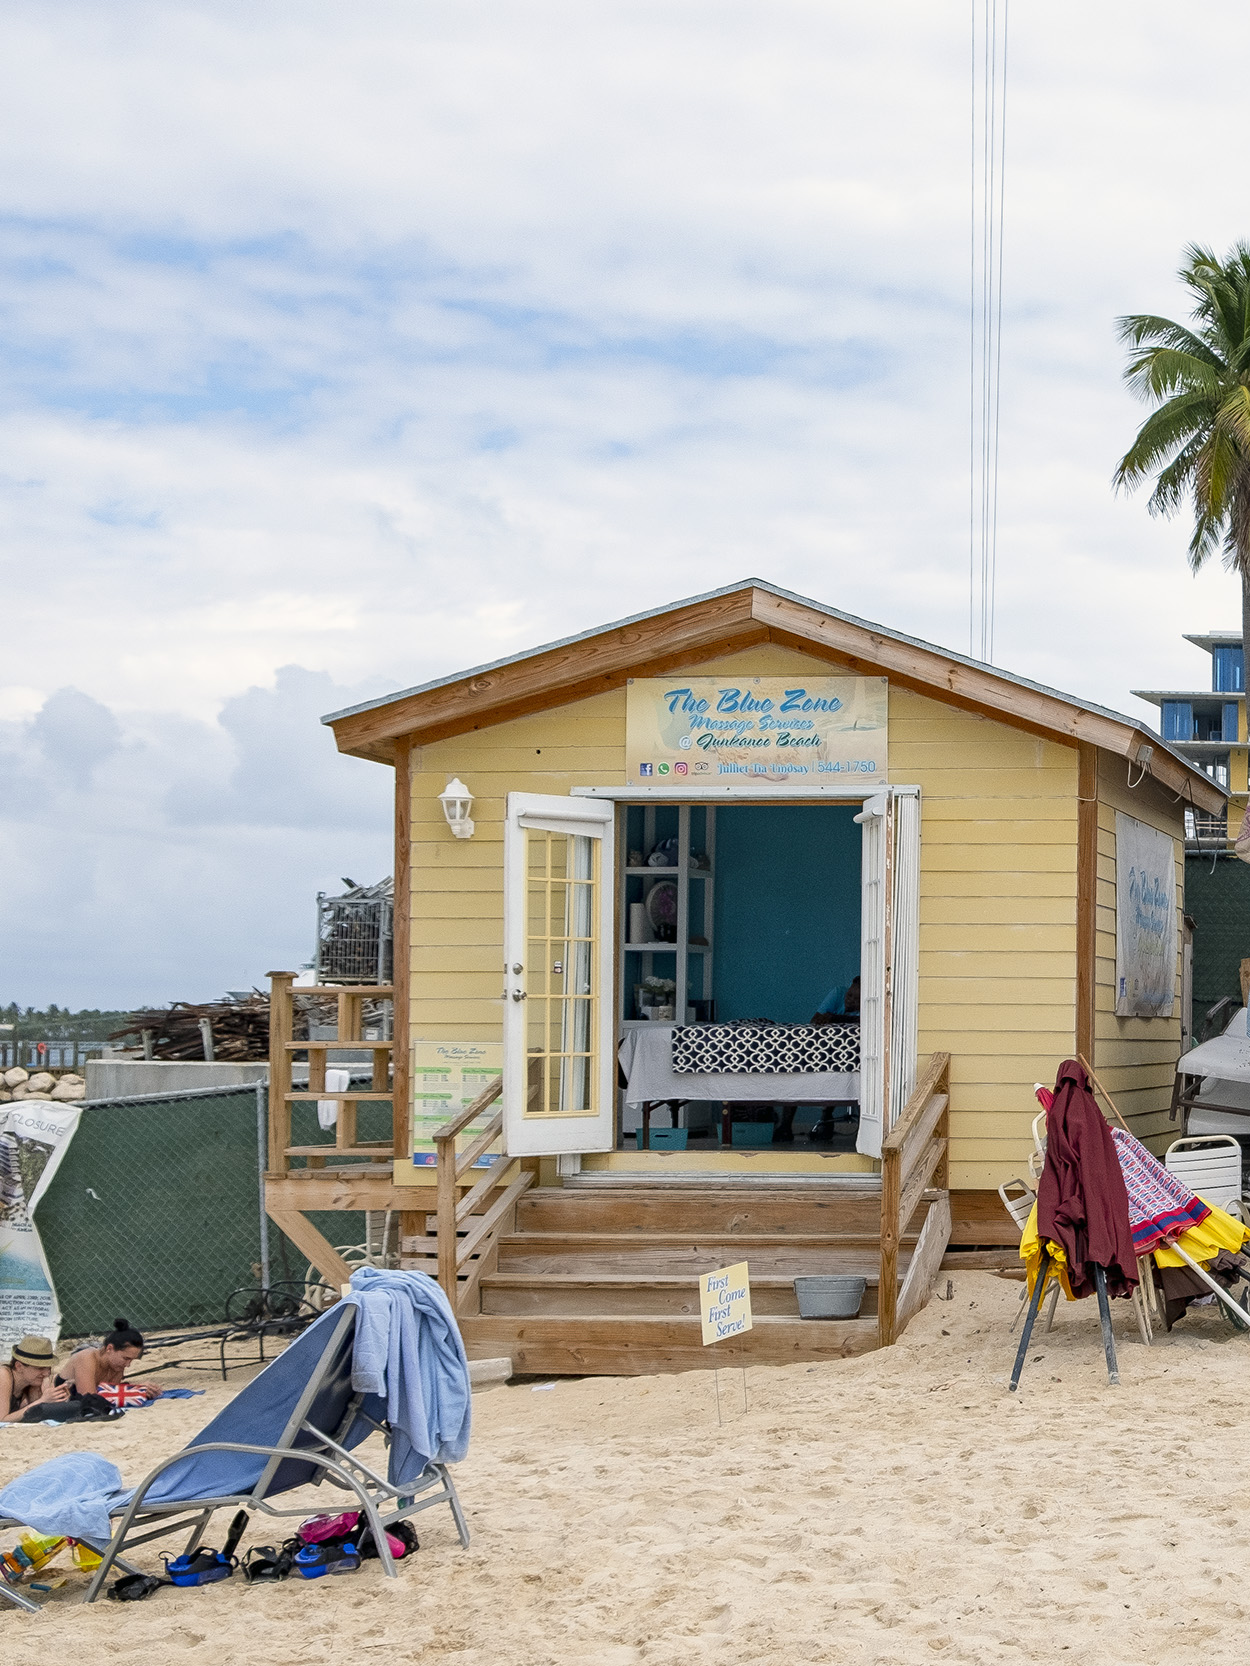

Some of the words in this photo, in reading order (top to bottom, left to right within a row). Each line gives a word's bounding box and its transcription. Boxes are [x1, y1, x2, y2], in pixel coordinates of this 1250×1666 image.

[663, 687, 710, 715] The
[716, 687, 774, 714] Blue
[779, 687, 844, 713] Zone
[688, 715, 754, 735] Massage
[758, 714, 816, 731] Services
[678, 735, 693, 750] @
[696, 732, 771, 752] Junkanoo
[775, 732, 823, 749] Beach
[817, 761, 876, 773] 544-1750
[12, 1113, 66, 1137] CLOSURE
[707, 1274, 729, 1293] First
[718, 1287, 746, 1305] Come
[708, 1304, 731, 1324] First
[716, 1313, 746, 1337] Serve!
